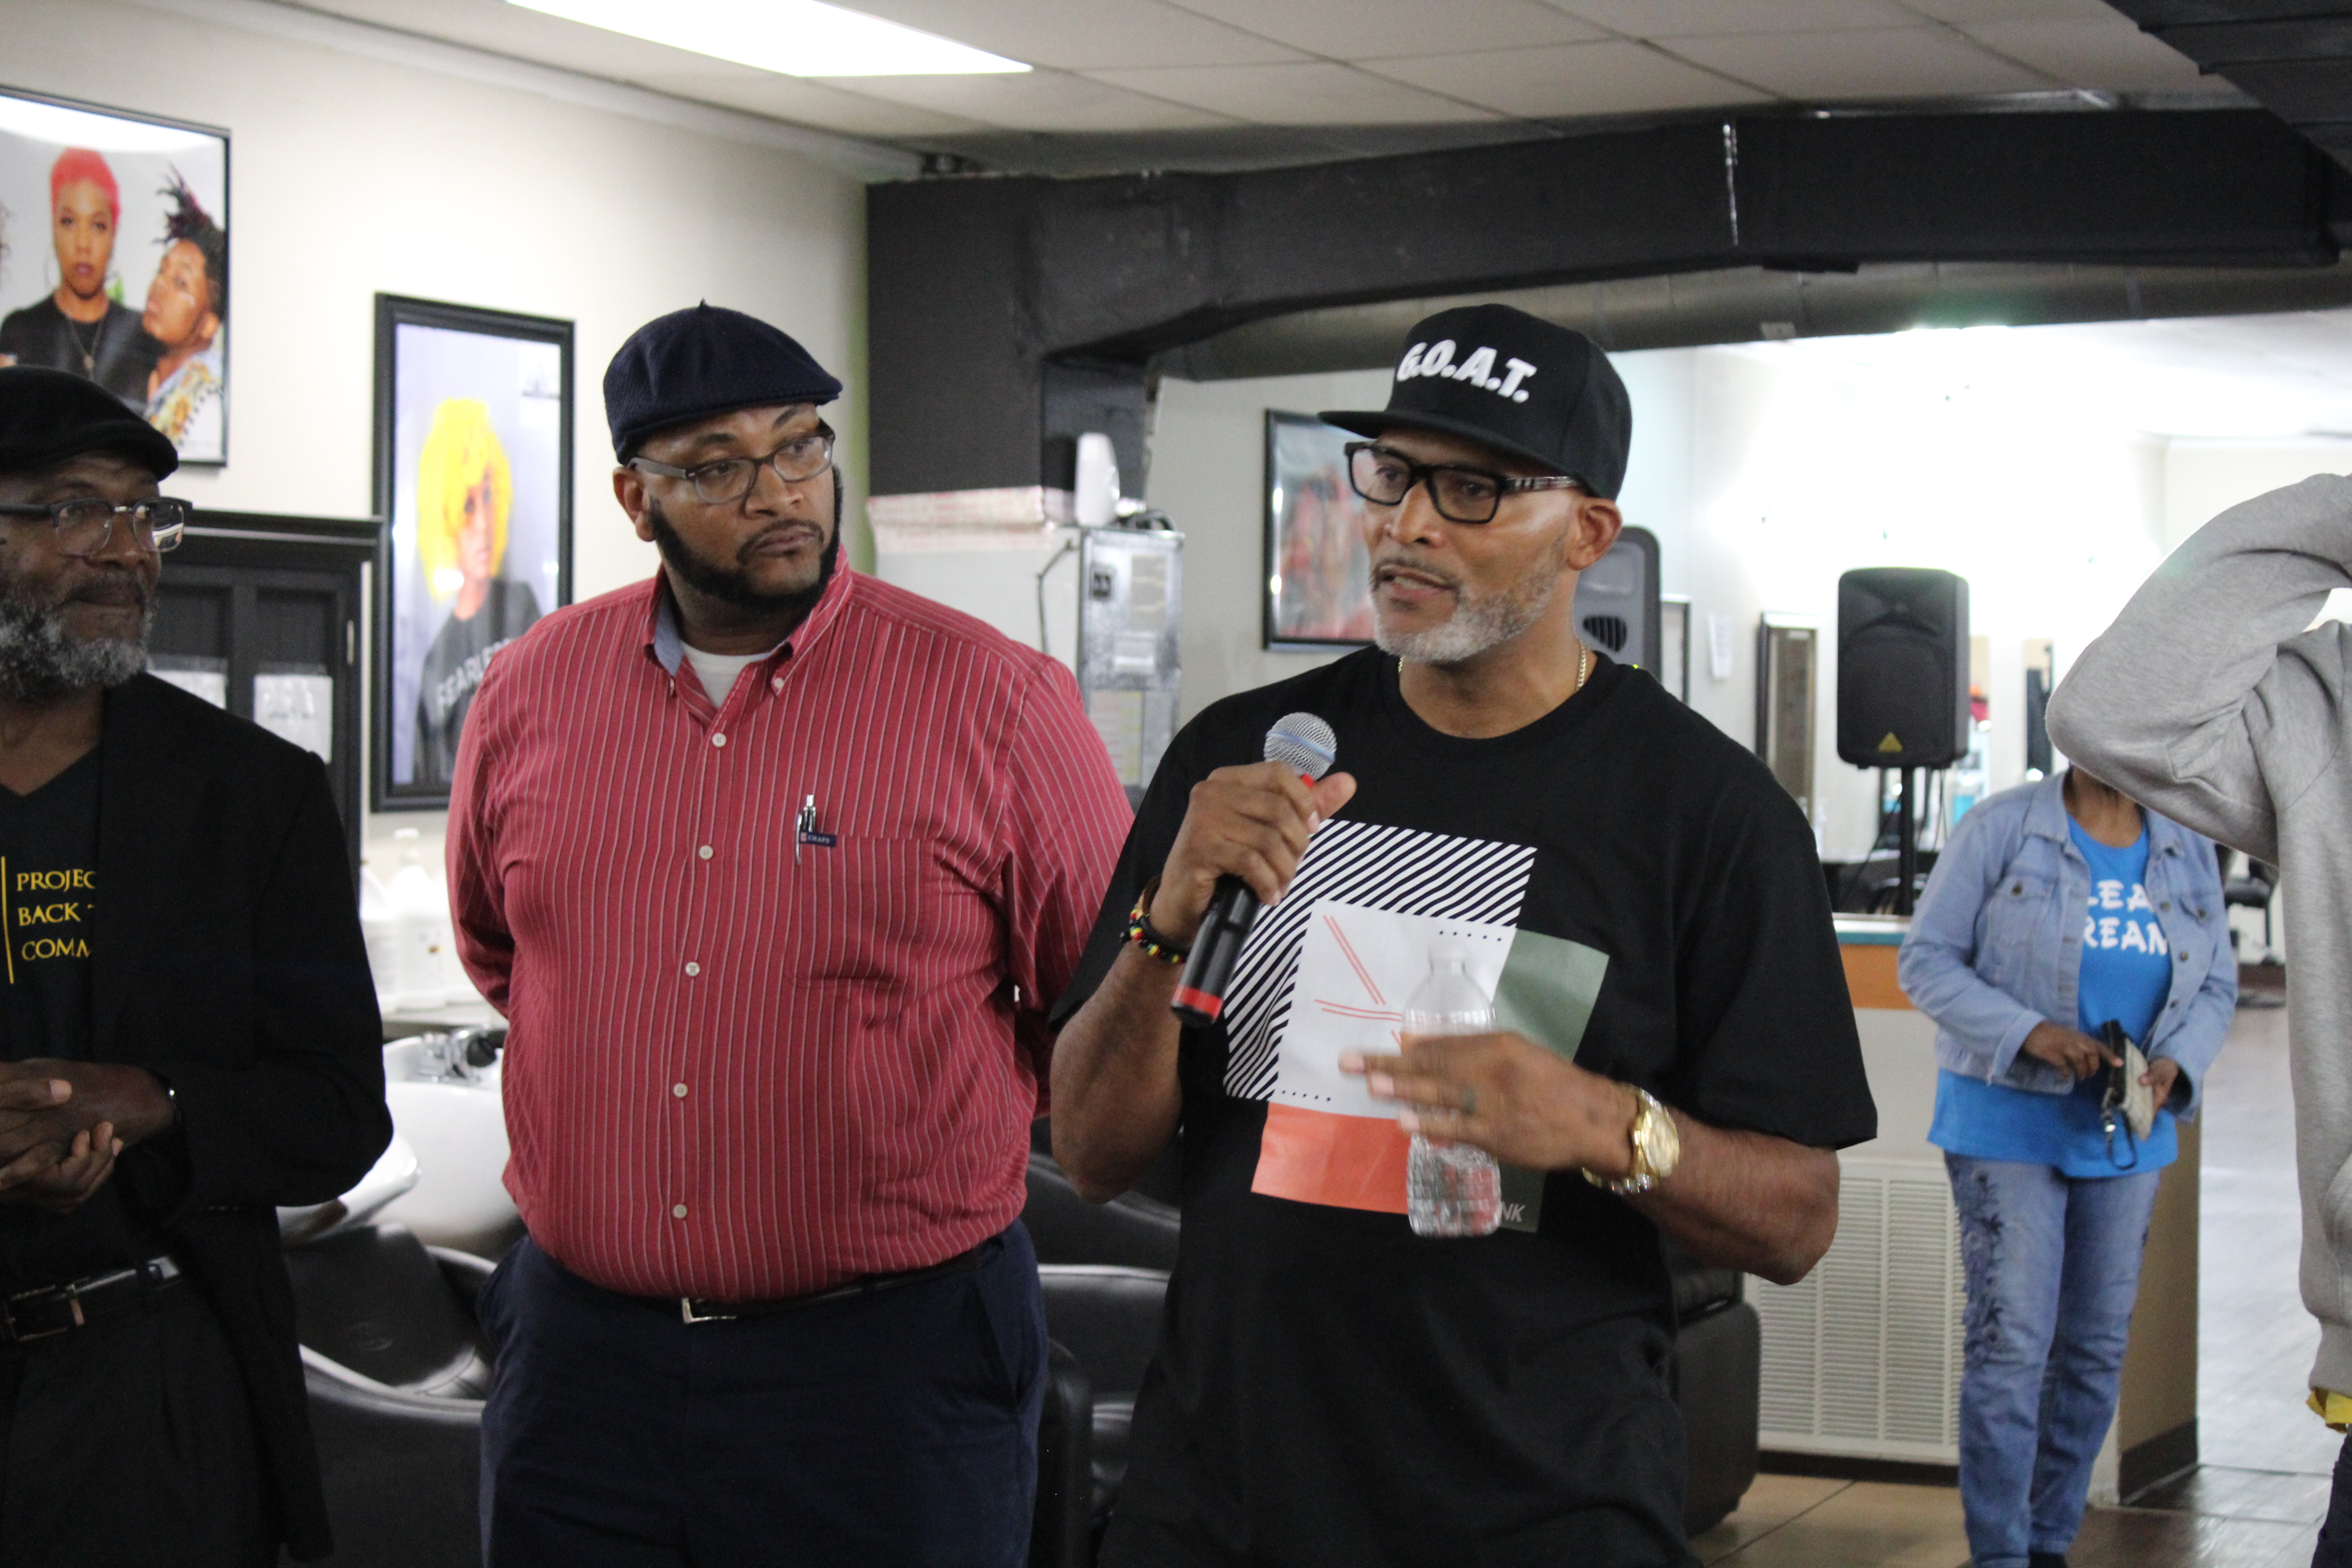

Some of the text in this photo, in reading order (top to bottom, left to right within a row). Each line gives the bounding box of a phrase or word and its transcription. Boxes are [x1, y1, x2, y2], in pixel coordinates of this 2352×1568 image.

[1397, 339, 1537, 403] G.O.A.T.
[808, 835, 830, 844] CHAPS
[17, 868, 96, 892] PROJEC
[2087, 879, 2155, 913] EA
[18, 902, 81, 926] BACK
